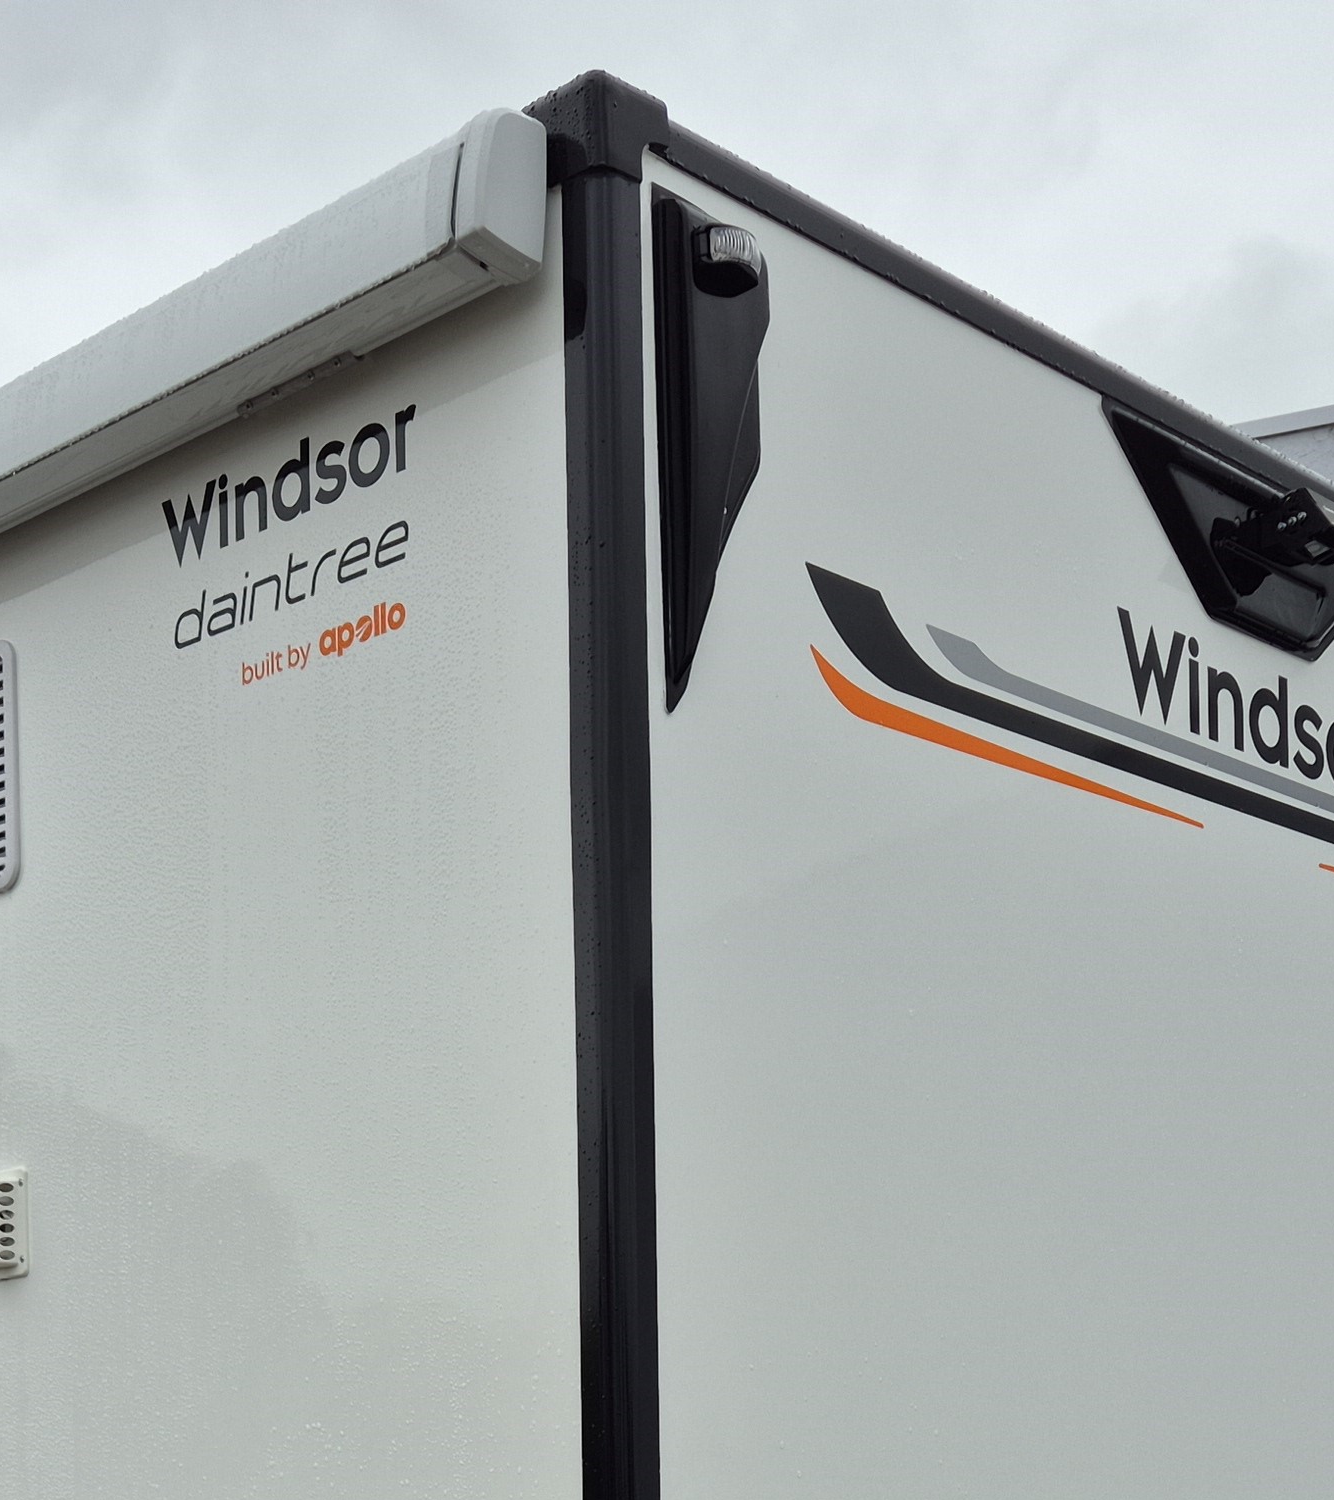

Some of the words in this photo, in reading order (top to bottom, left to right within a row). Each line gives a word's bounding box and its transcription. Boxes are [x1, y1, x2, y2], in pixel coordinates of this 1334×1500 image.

[161, 403, 416, 568] Windsor
[174, 520, 409, 650] daintree
[241, 651, 283, 686] built
[287, 642, 311, 670] by
[319, 602, 406, 657] apollo
